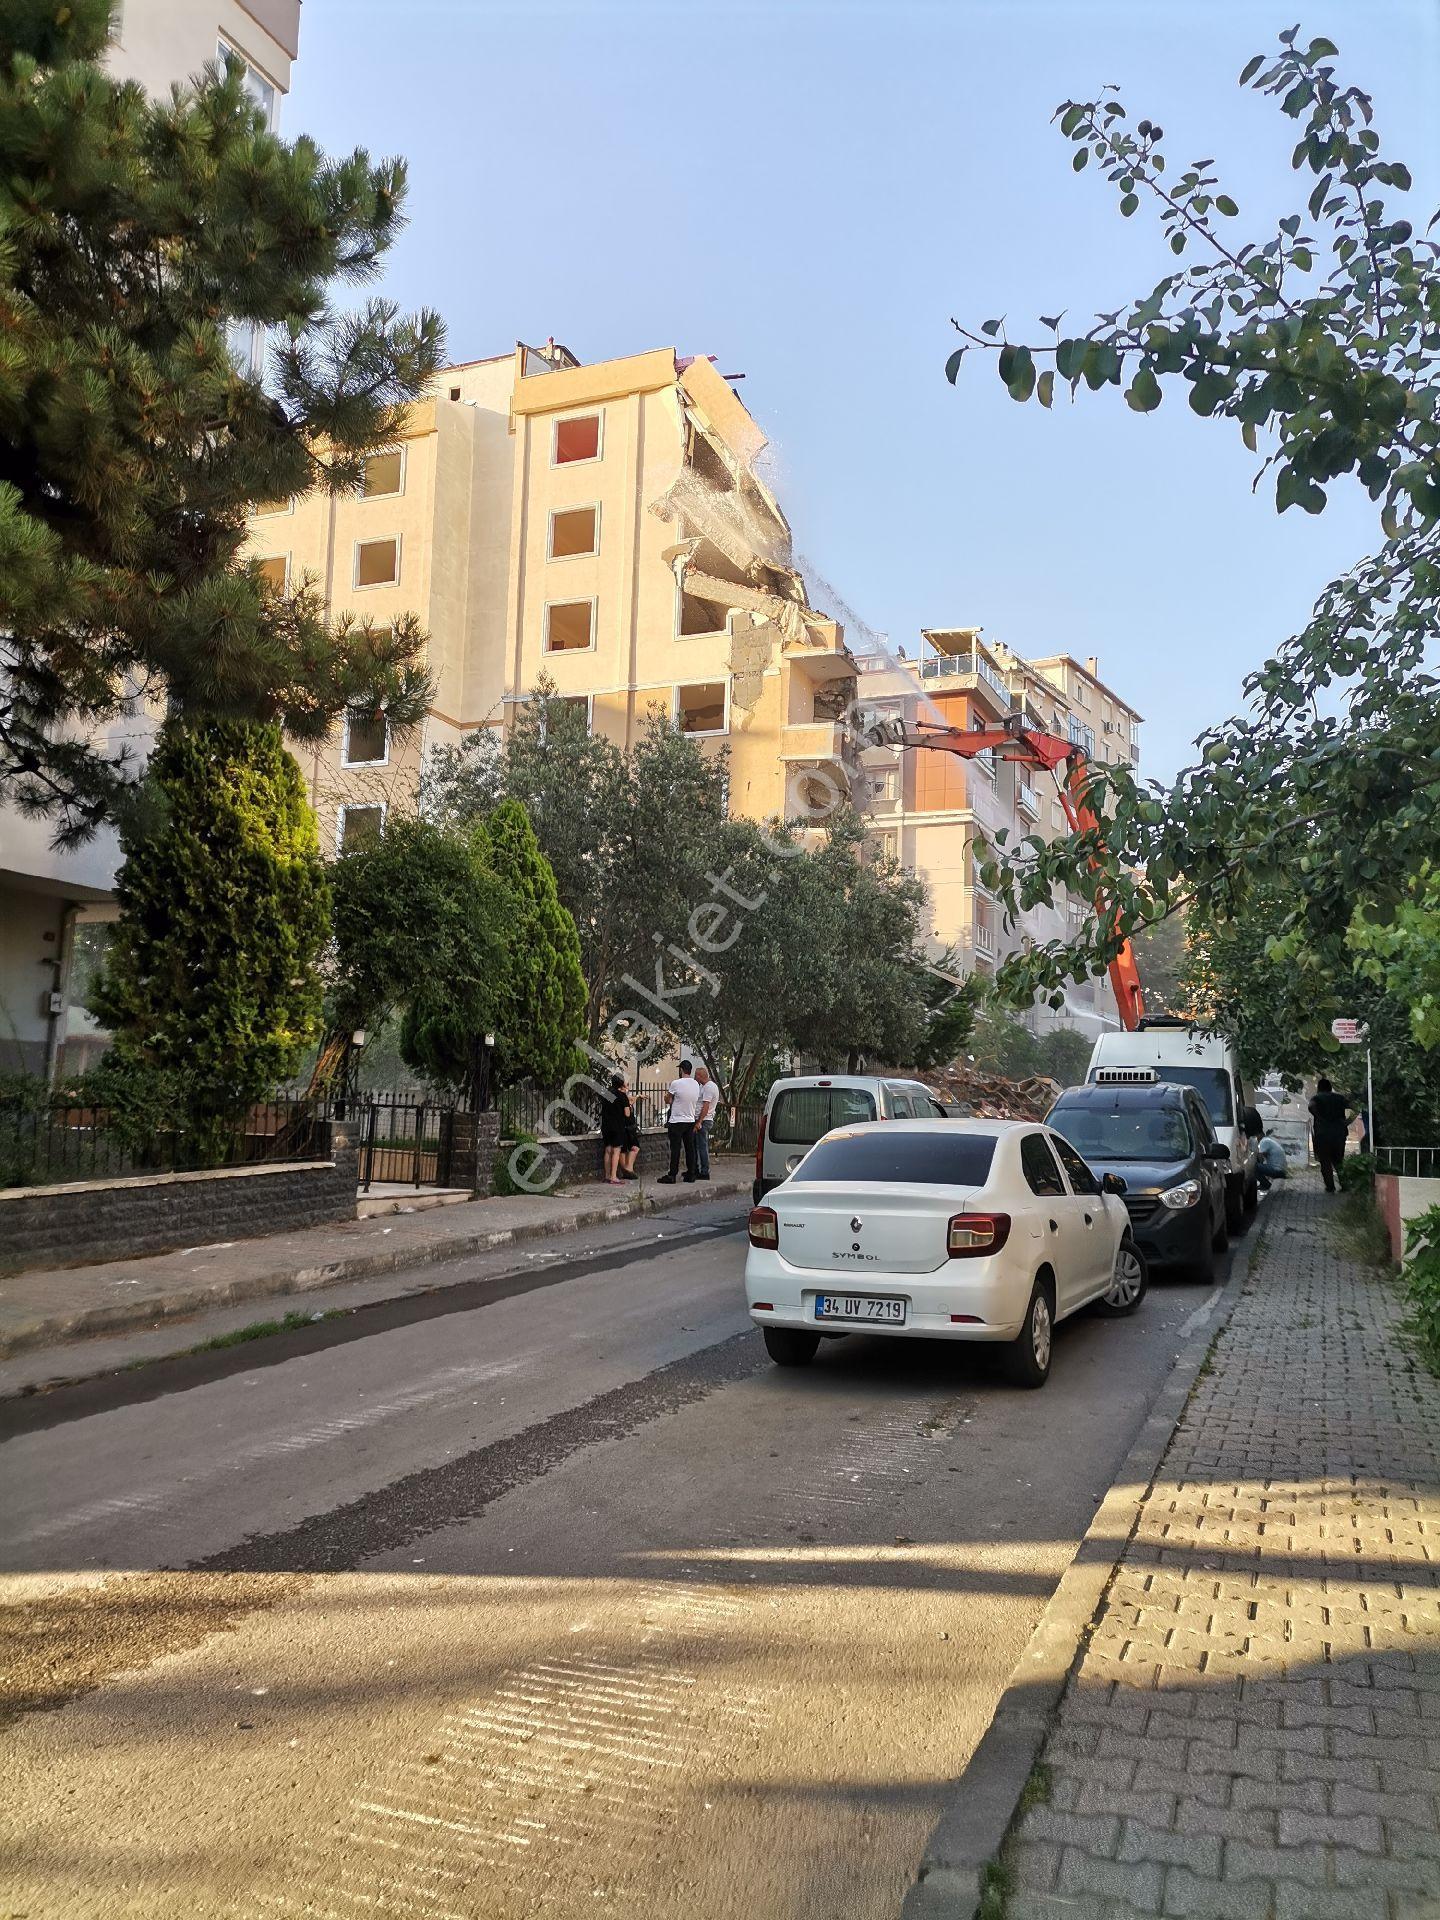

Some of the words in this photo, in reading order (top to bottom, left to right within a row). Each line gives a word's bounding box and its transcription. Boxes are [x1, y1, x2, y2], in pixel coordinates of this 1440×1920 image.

[832, 1252, 880, 1261] SYMBOL
[824, 1298, 839, 1313] 34
[845, 1299, 861, 1315] UV
[867, 1301, 901, 1318] 7219
